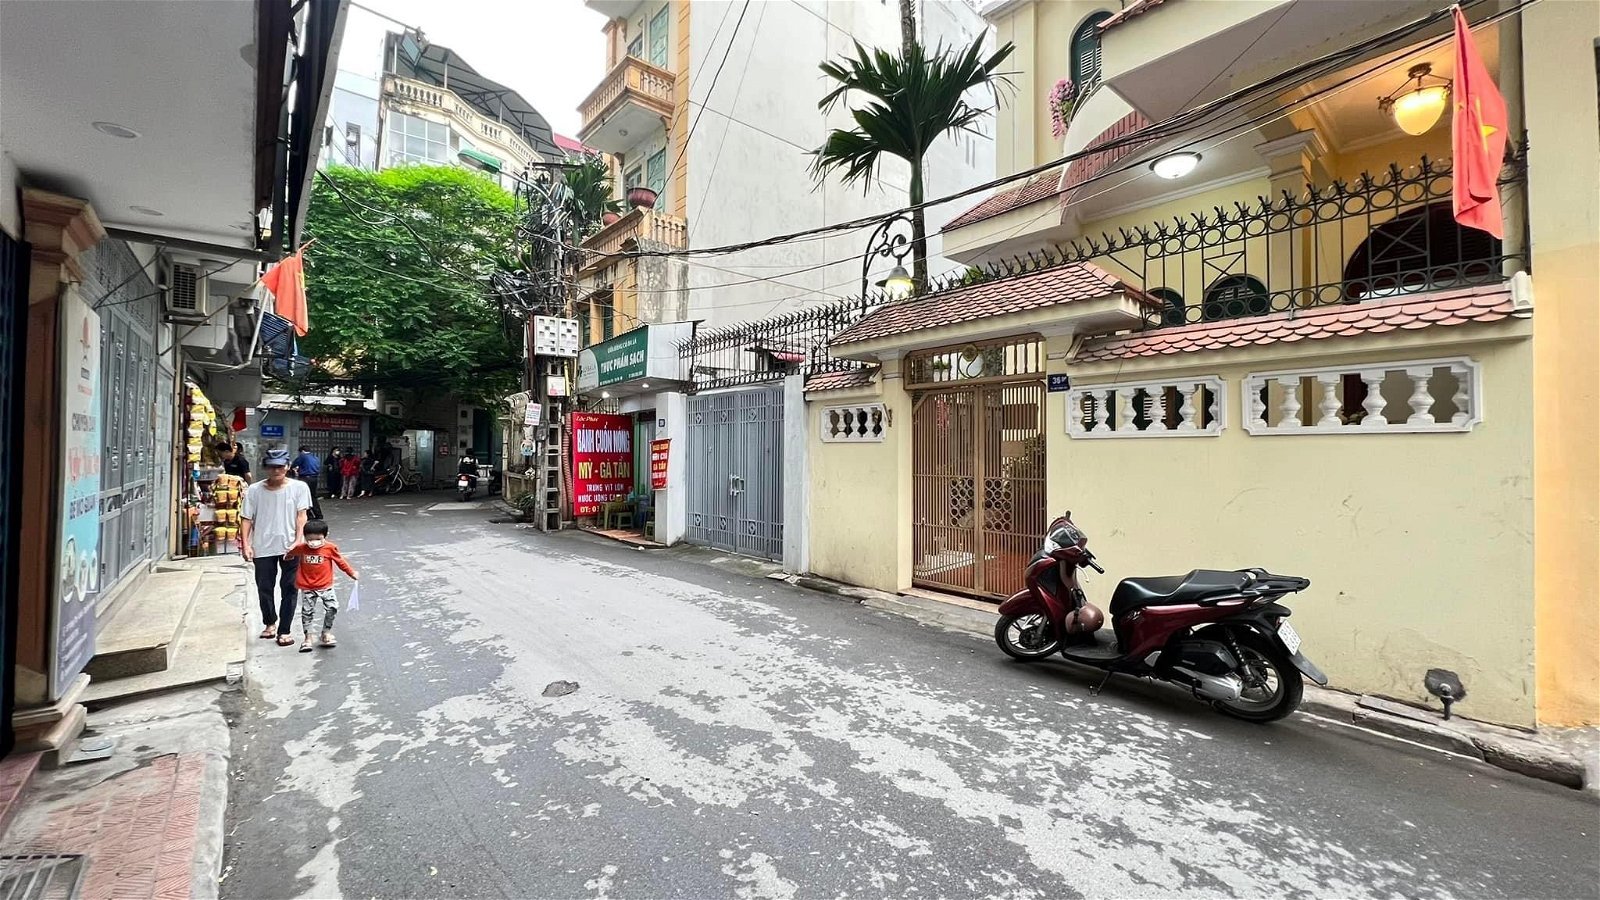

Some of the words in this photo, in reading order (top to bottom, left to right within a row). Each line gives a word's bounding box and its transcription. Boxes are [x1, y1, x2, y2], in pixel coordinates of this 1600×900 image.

[601, 359, 613, 375] THỰC
[613, 352, 629, 370] PHẨM
[630, 350, 645, 368] SẠCH
[577, 423, 594, 453] BÁNH
[595, 421, 612, 453] CUỐN
[613, 426, 630, 453] NÓNG
[600, 458, 613, 479] GÀ
[613, 456, 630, 478] TẦN
